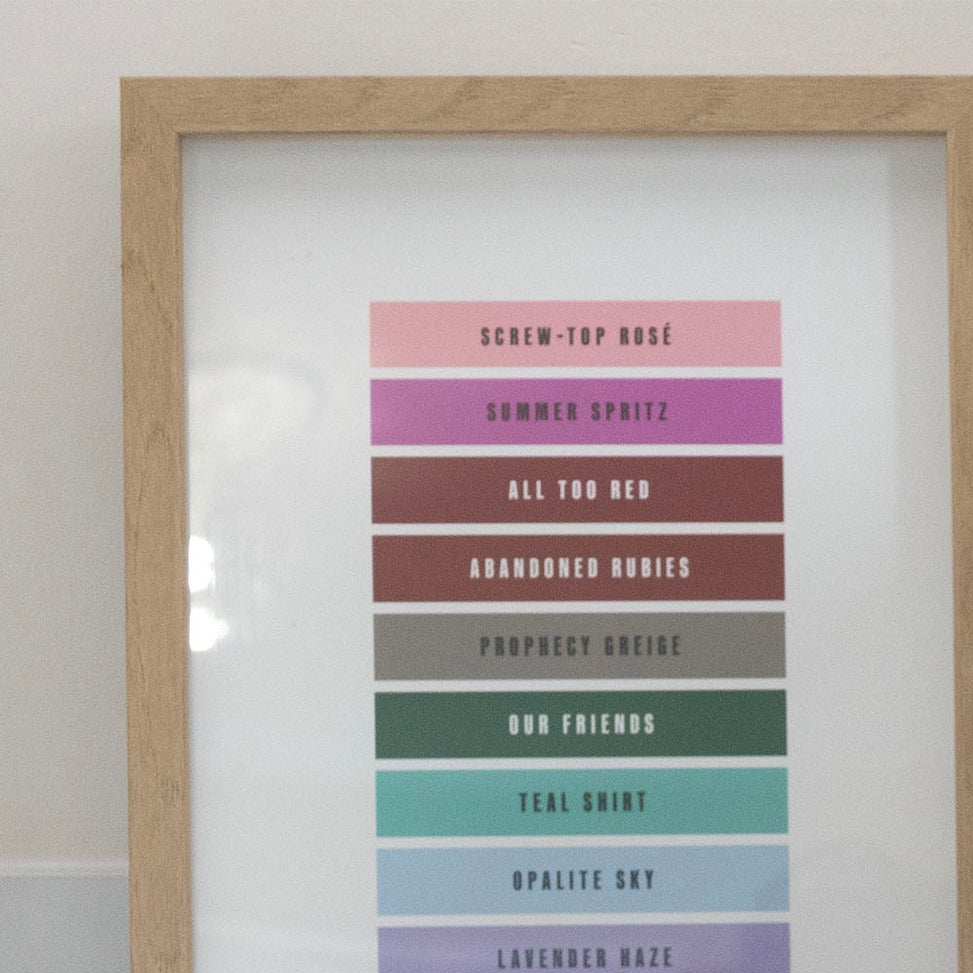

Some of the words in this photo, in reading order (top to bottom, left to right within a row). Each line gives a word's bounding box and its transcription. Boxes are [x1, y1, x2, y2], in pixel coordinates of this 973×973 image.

[480, 326, 607, 346] SCREW-TOP
[619, 323, 672, 346] ROSÉ
[486, 402, 578, 421] SUMMER
[590, 402, 668, 421] SPRITZ
[508, 480, 545, 500] ALL
[557, 480, 597, 499] TOO
[610, 480, 650, 499] RED
[470, 558, 599, 579] ABANDONED
[611, 557, 690, 578] RUBIES
[480, 636, 591, 656] PROPHECY
[604, 635, 681, 656] GREIGE
[508, 714, 549, 735] OUR
[562, 713, 655, 734] FRIENDS
[519, 792, 569, 812] TEAL
[583, 791, 646, 812] SHIRT
[512, 870, 602, 890] OPALITE
[616, 870, 655, 890] SKY
[497, 949, 606, 969] LAVENDER
[620, 947, 673, 967] HAZE
